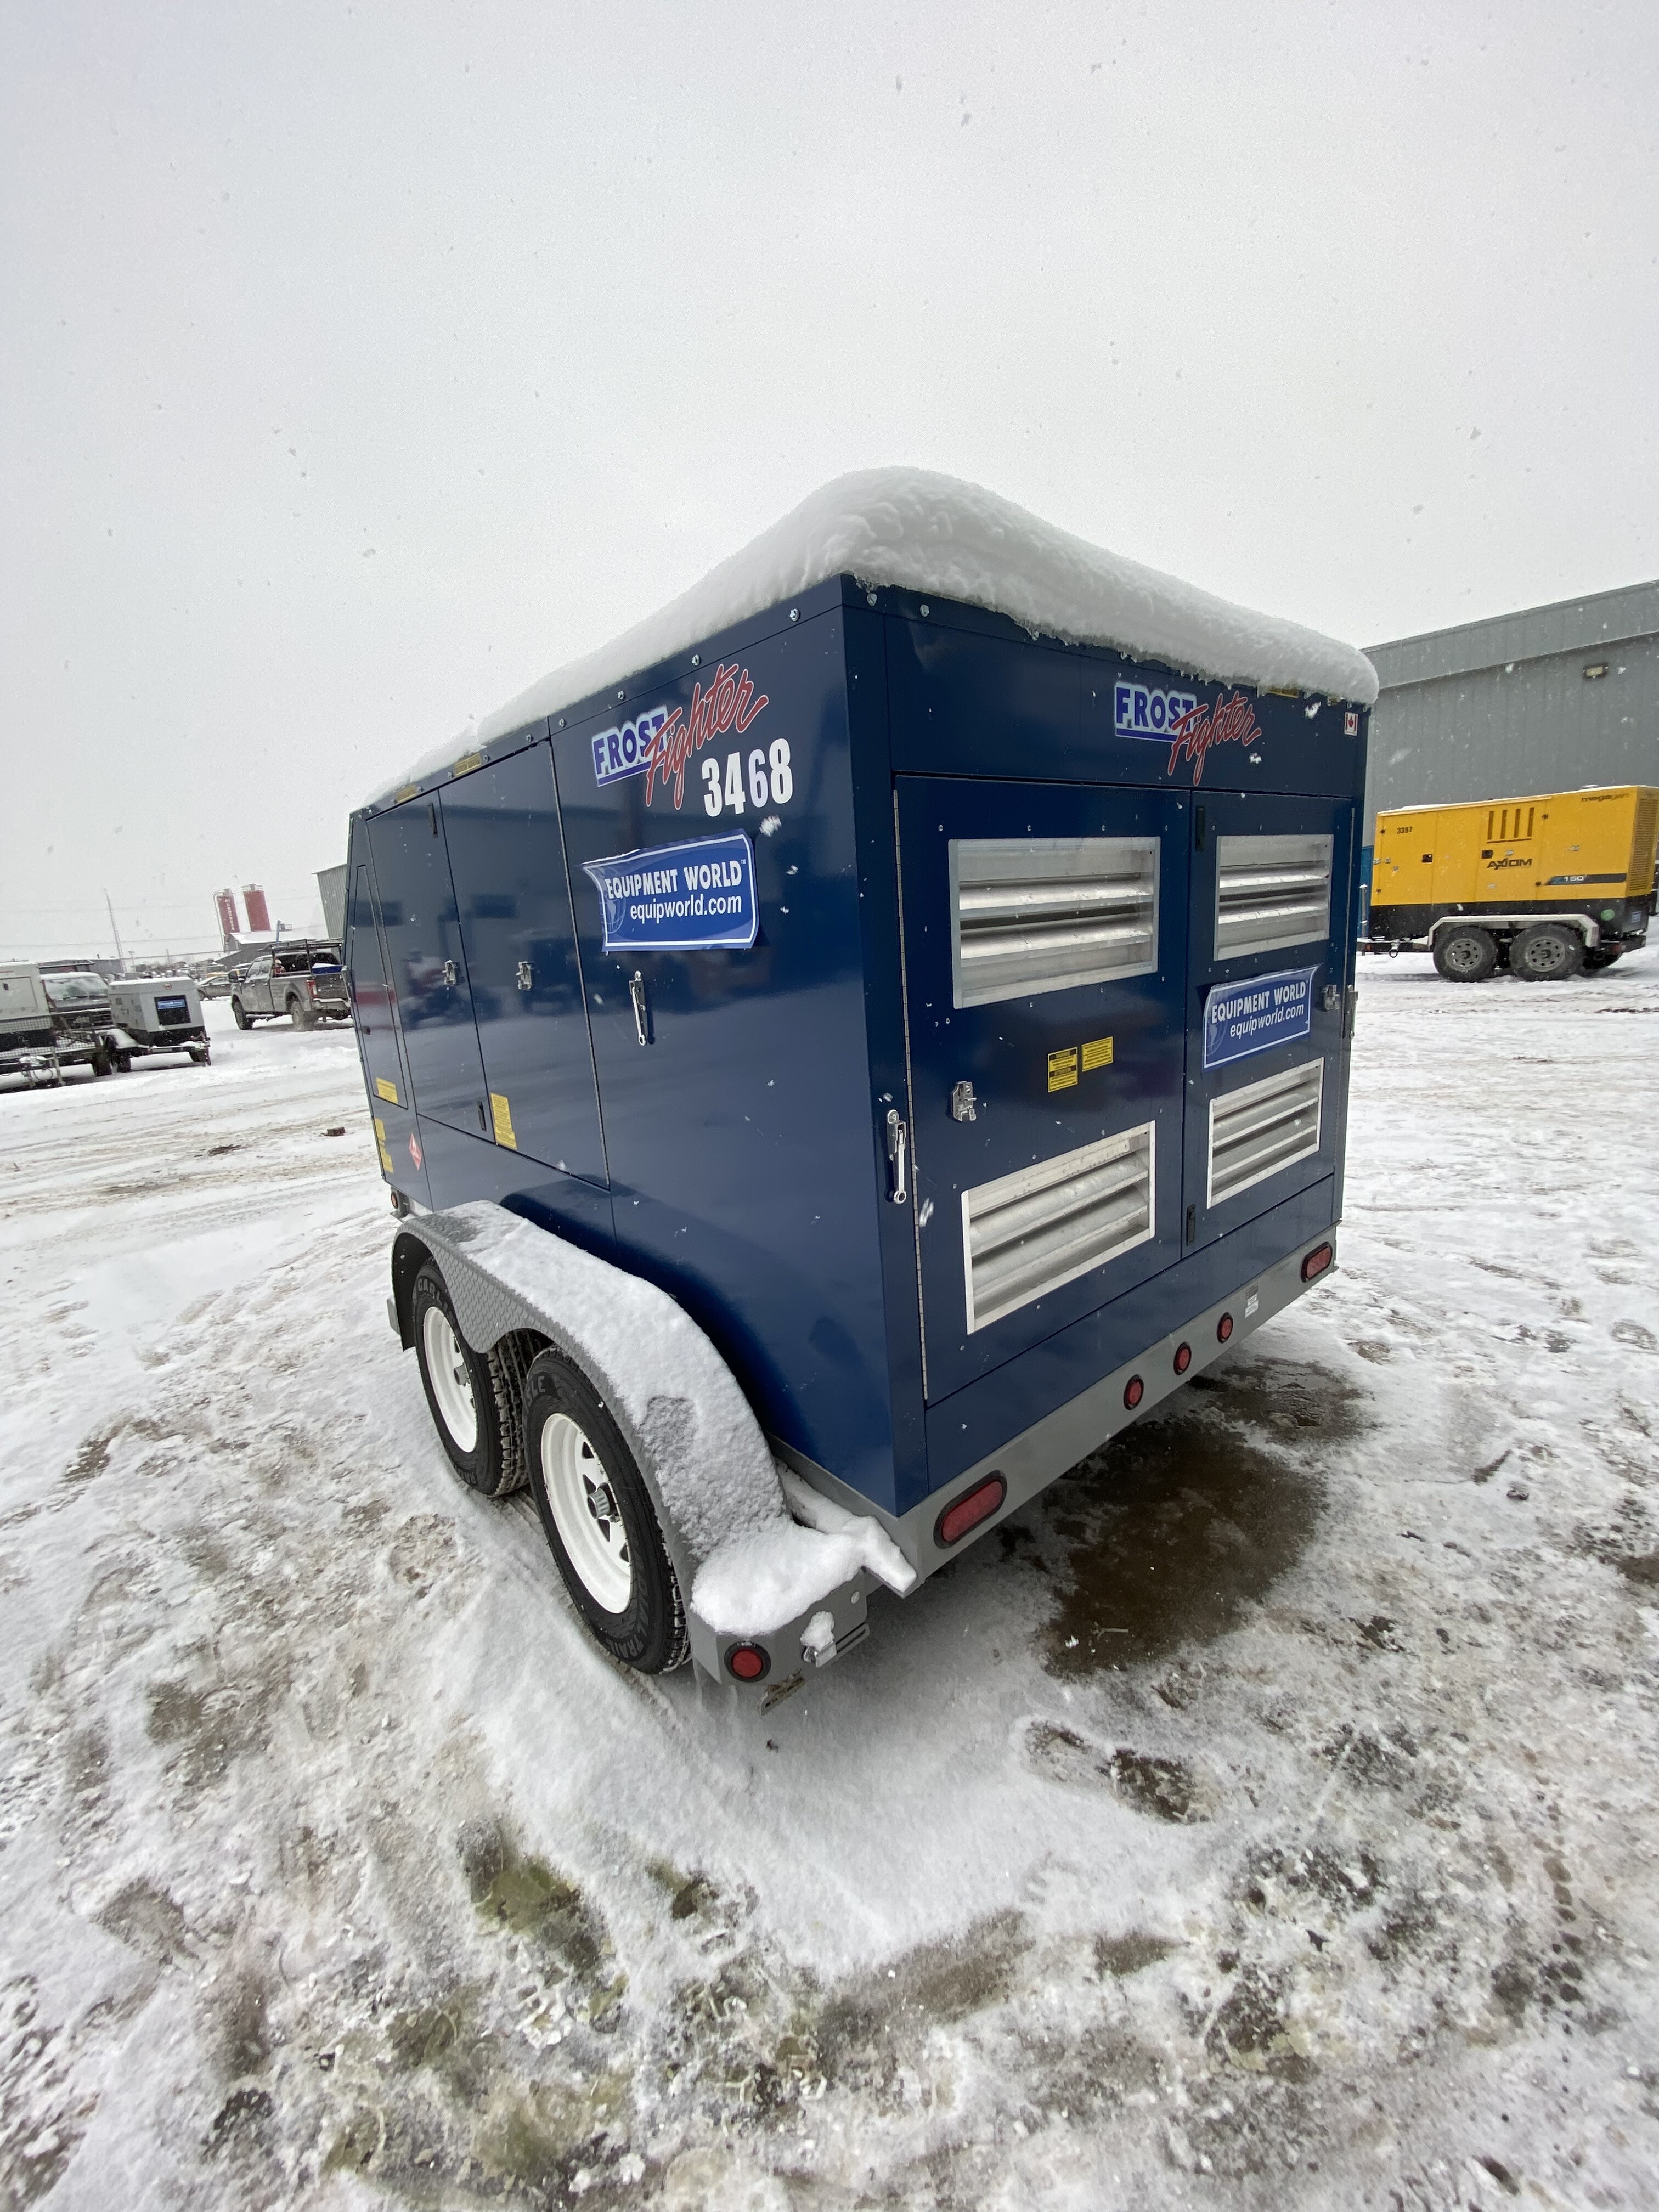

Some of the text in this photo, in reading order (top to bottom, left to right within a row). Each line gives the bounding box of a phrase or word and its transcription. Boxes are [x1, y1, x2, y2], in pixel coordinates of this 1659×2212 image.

[592, 663, 769, 810] FROST Fighter
[1116, 687, 1261, 786] FROST Fighter
[702, 738, 793, 817] 3468
[1486, 857, 1533, 871] AXIOM
[604, 868, 678, 900] EQUIPMENT
[630, 894, 742, 924] equipworld.com
[1211, 981, 1306, 1024] EQUIPMENT WORLD
[1229, 1003, 1305, 1039] equipworld.com
